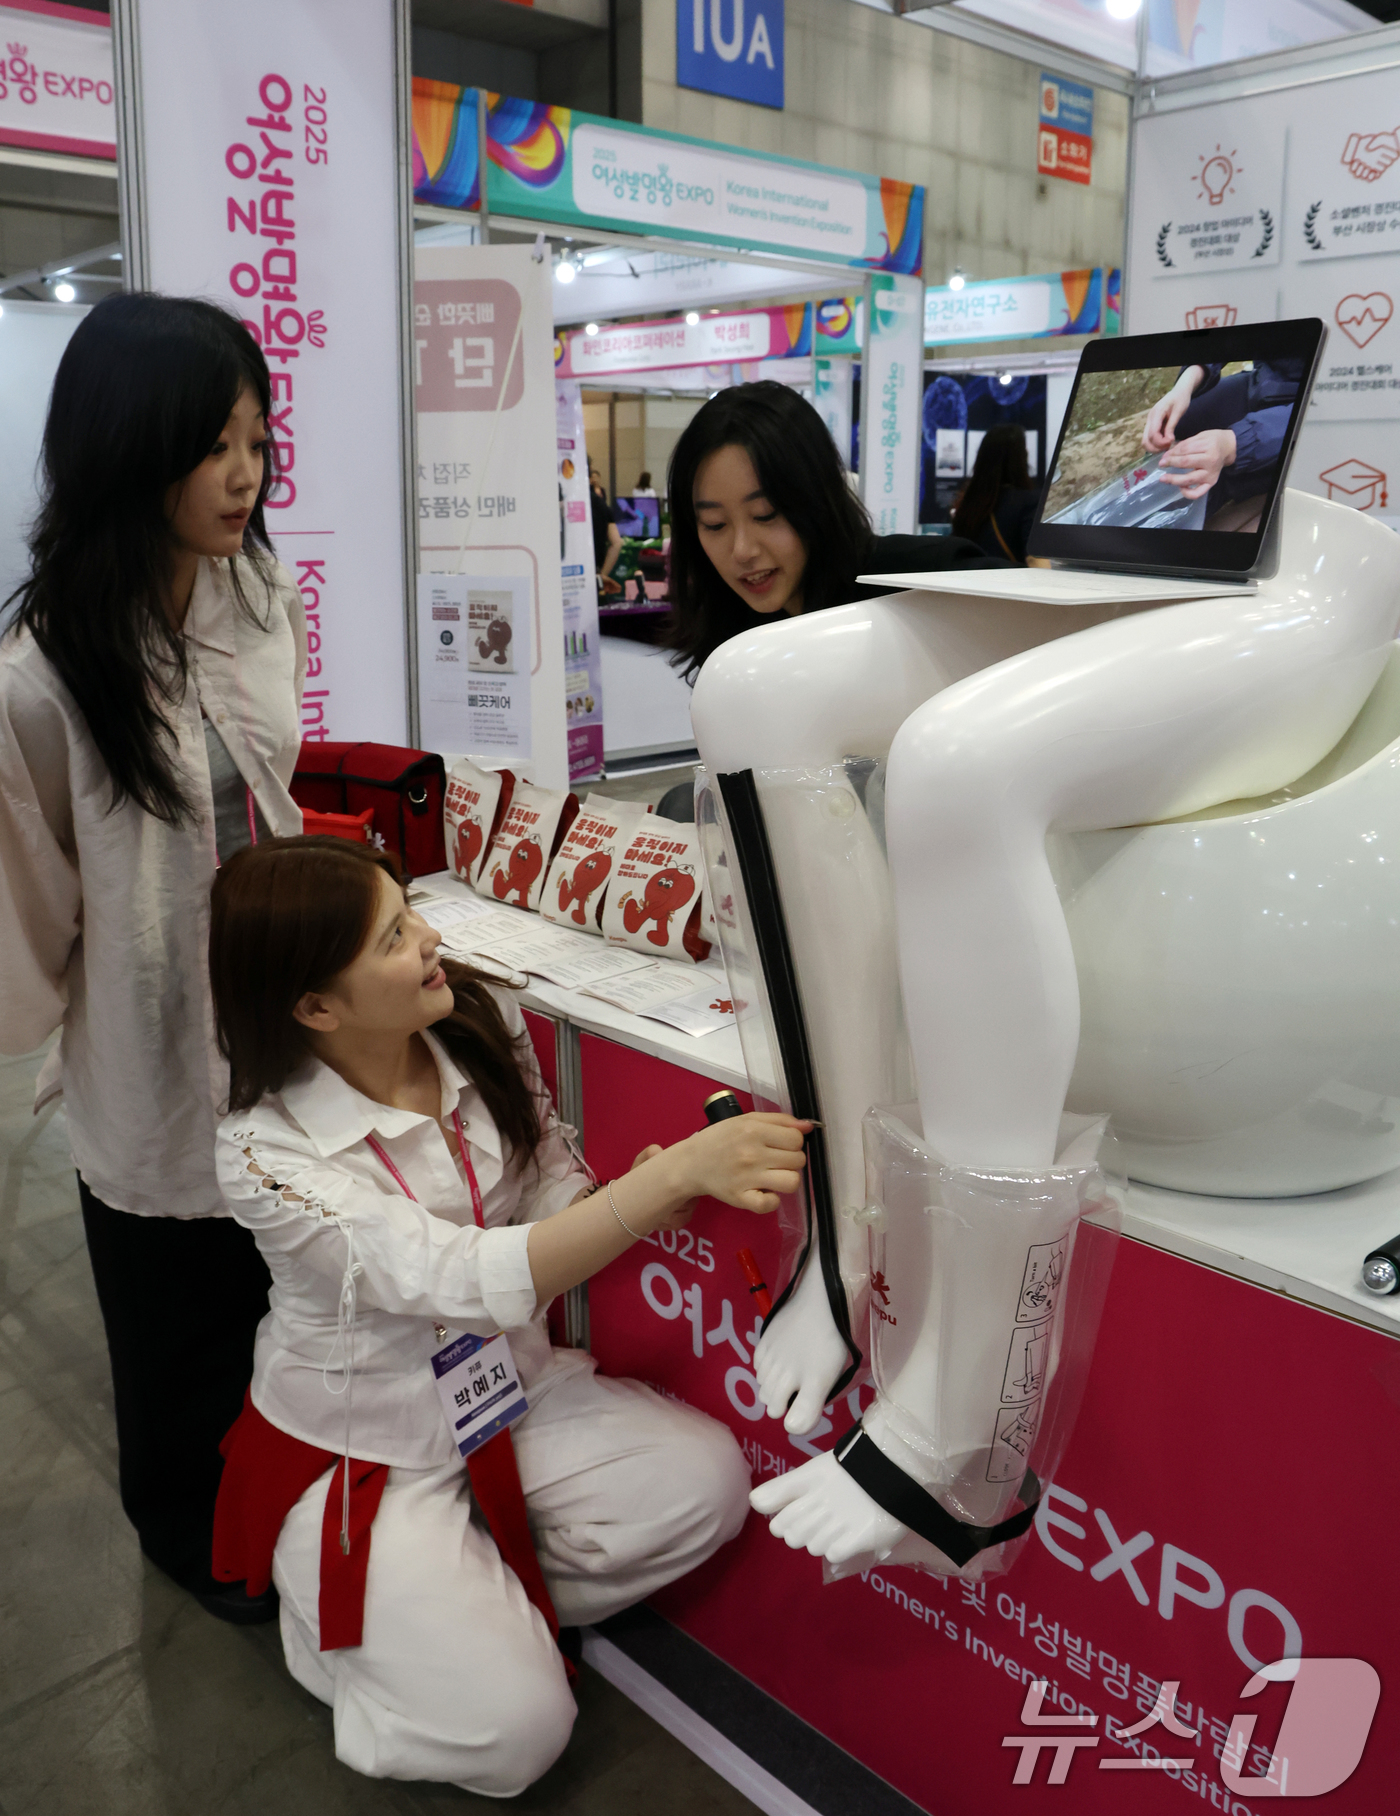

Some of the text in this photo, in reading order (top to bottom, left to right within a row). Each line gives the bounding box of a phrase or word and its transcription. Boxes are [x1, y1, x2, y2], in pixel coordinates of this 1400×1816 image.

[42, 70, 113, 106] EXPO
[303, 83, 328, 165] 2025
[591, 163, 714, 207] 여성발명왕 EXPO
[726, 181, 830, 212] Korea International
[224, 73, 306, 363] 여성발명왕
[926, 292, 1019, 322] 유전자연구소
[713, 322, 751, 340] 박성희
[295, 560, 329, 678] Korea
[447, 781, 481, 806] 움직이지
[506, 806, 541, 825] 움직이지
[575, 818, 618, 839] 움직이지
[566, 830, 604, 851] 마세요!
[631, 836, 689, 856] 움직이지
[624, 847, 673, 868] 마세요!
[1033, 1483, 1303, 1682] EXPO
[964, 1626, 1097, 1728] Invention
[996, 1592, 1290, 1796] 여성발명품박람회
